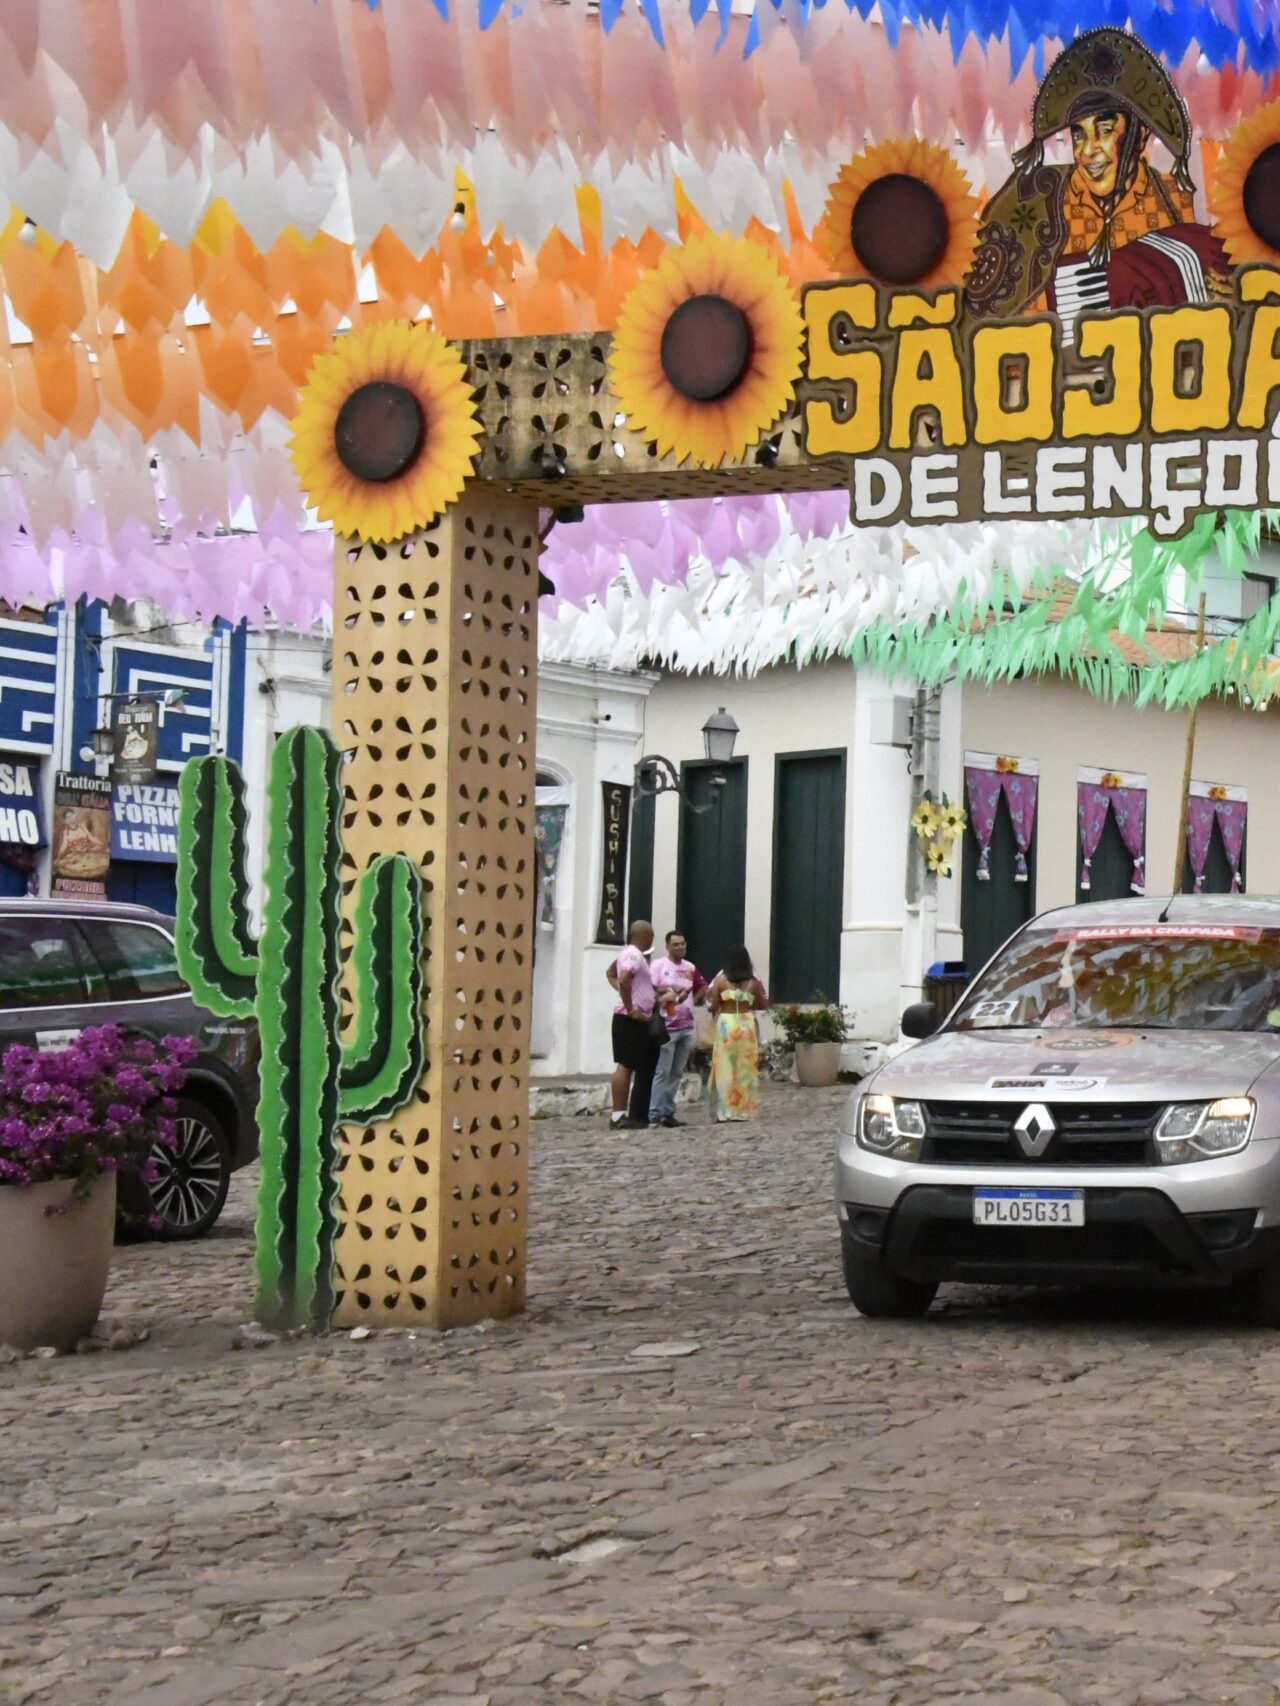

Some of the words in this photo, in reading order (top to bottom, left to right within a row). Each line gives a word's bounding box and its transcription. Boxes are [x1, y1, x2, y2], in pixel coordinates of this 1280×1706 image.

[805, 283, 1053, 456] SÃO
[854, 454, 958, 521] DE
[57, 771, 112, 793] Trattoria
[117, 785, 181, 808] PIZZA
[119, 829, 178, 854] LENH
[608, 789, 622, 873] SUSHI
[606, 883, 619, 935] BAR
[1077, 928, 1130, 938] RALLY
[1130, 927, 1154, 936] DA
[1154, 927, 1235, 937] CHAPADA
[976, 1002, 1011, 1017] 22
